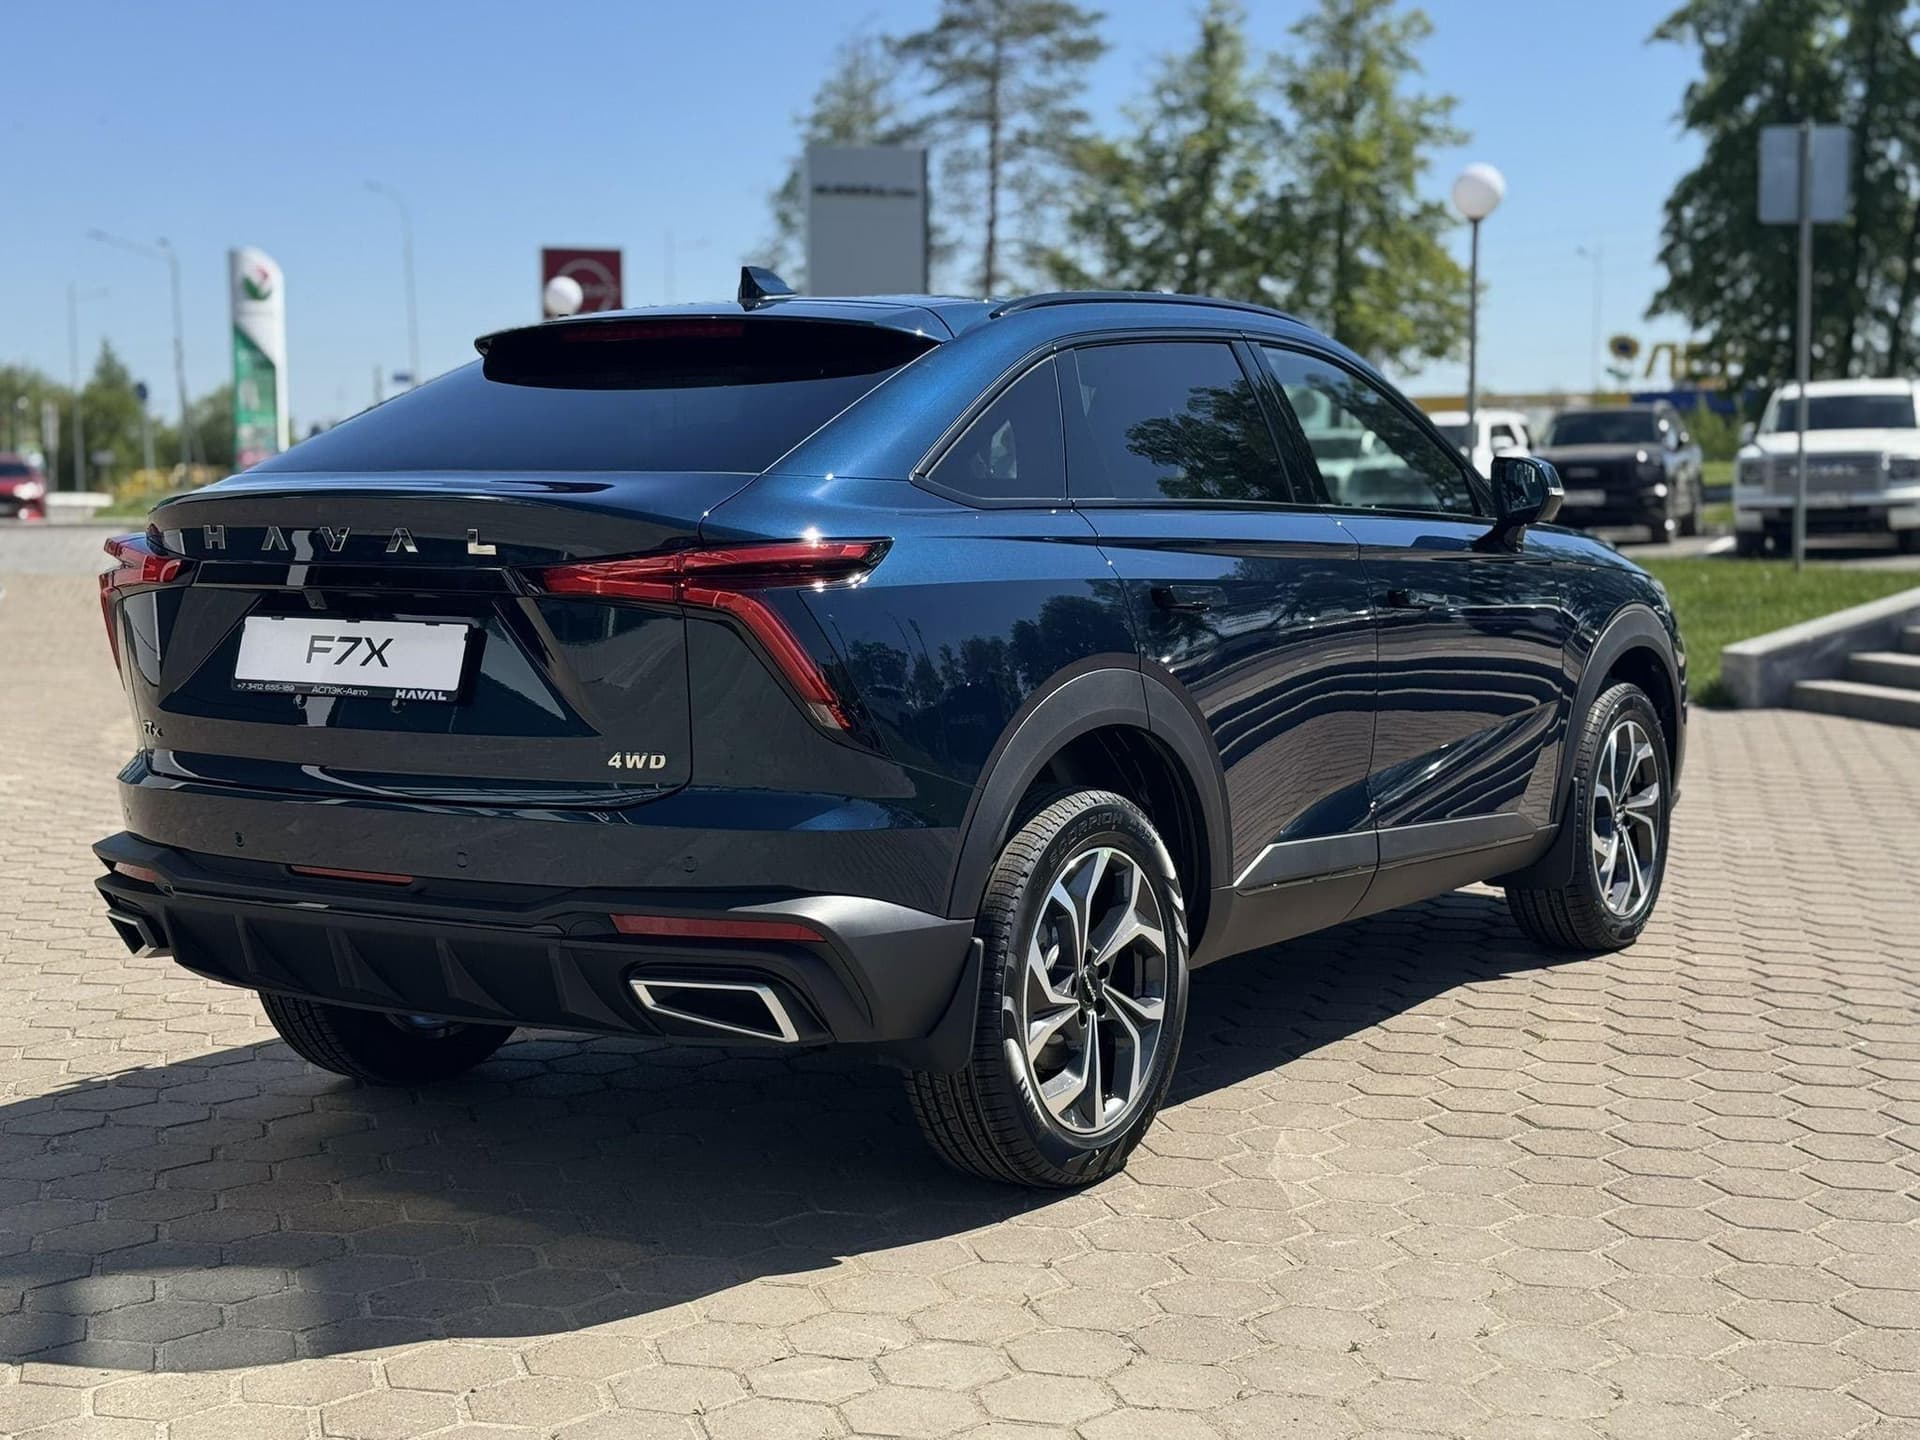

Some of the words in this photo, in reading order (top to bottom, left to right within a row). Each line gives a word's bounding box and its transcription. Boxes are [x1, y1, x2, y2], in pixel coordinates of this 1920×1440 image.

[203, 525, 496, 555] HAVAL
[306, 634, 394, 668] F7X
[311, 685, 369, 697] АСПЭК-Авто
[395, 689, 448, 701] HAVAL
[607, 751, 667, 769] 4WD
